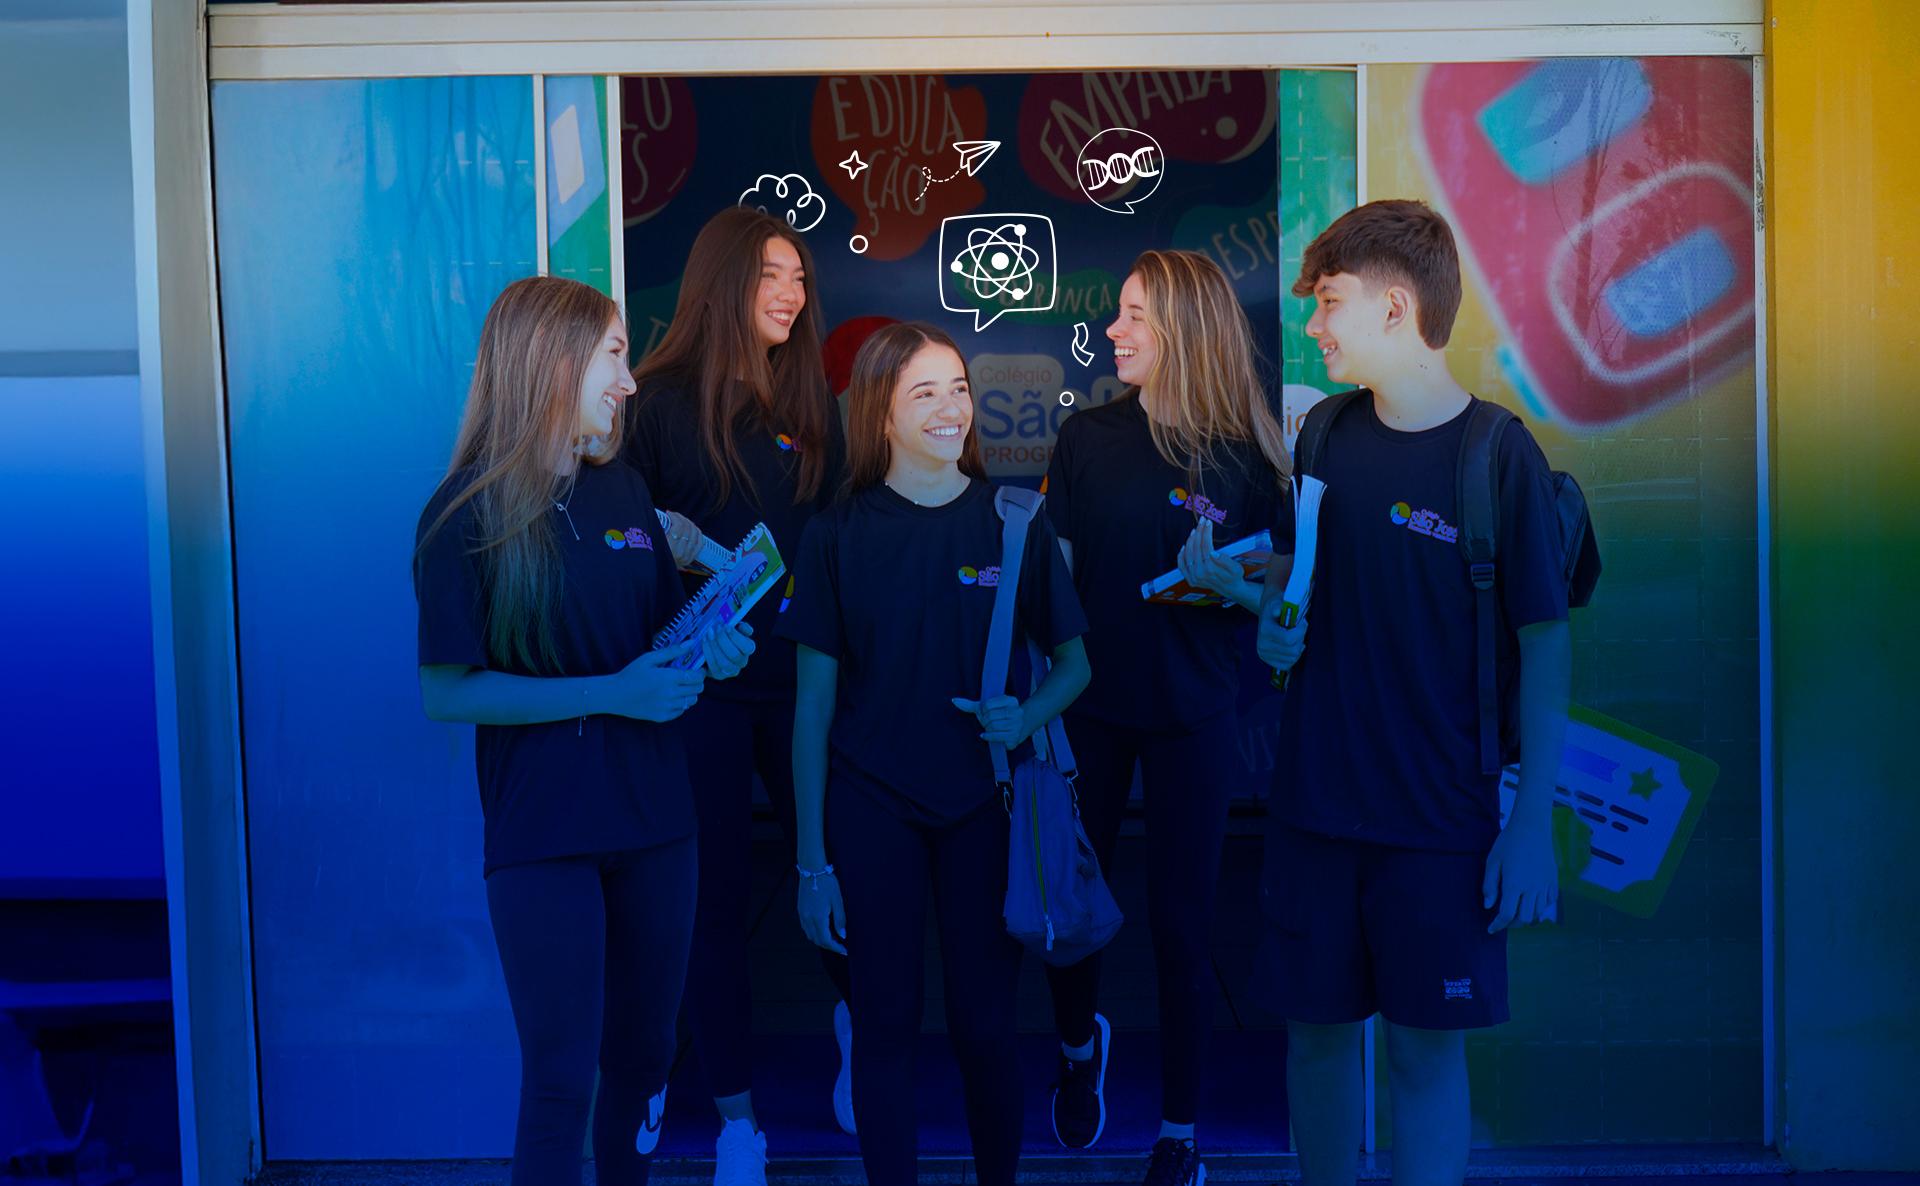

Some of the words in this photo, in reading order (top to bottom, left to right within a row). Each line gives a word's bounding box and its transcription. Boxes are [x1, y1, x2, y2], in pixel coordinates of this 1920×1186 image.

[828, 74, 964, 156] EDUCA
[980, 366, 1053, 387] Colégio
[979, 389, 1081, 440] São
